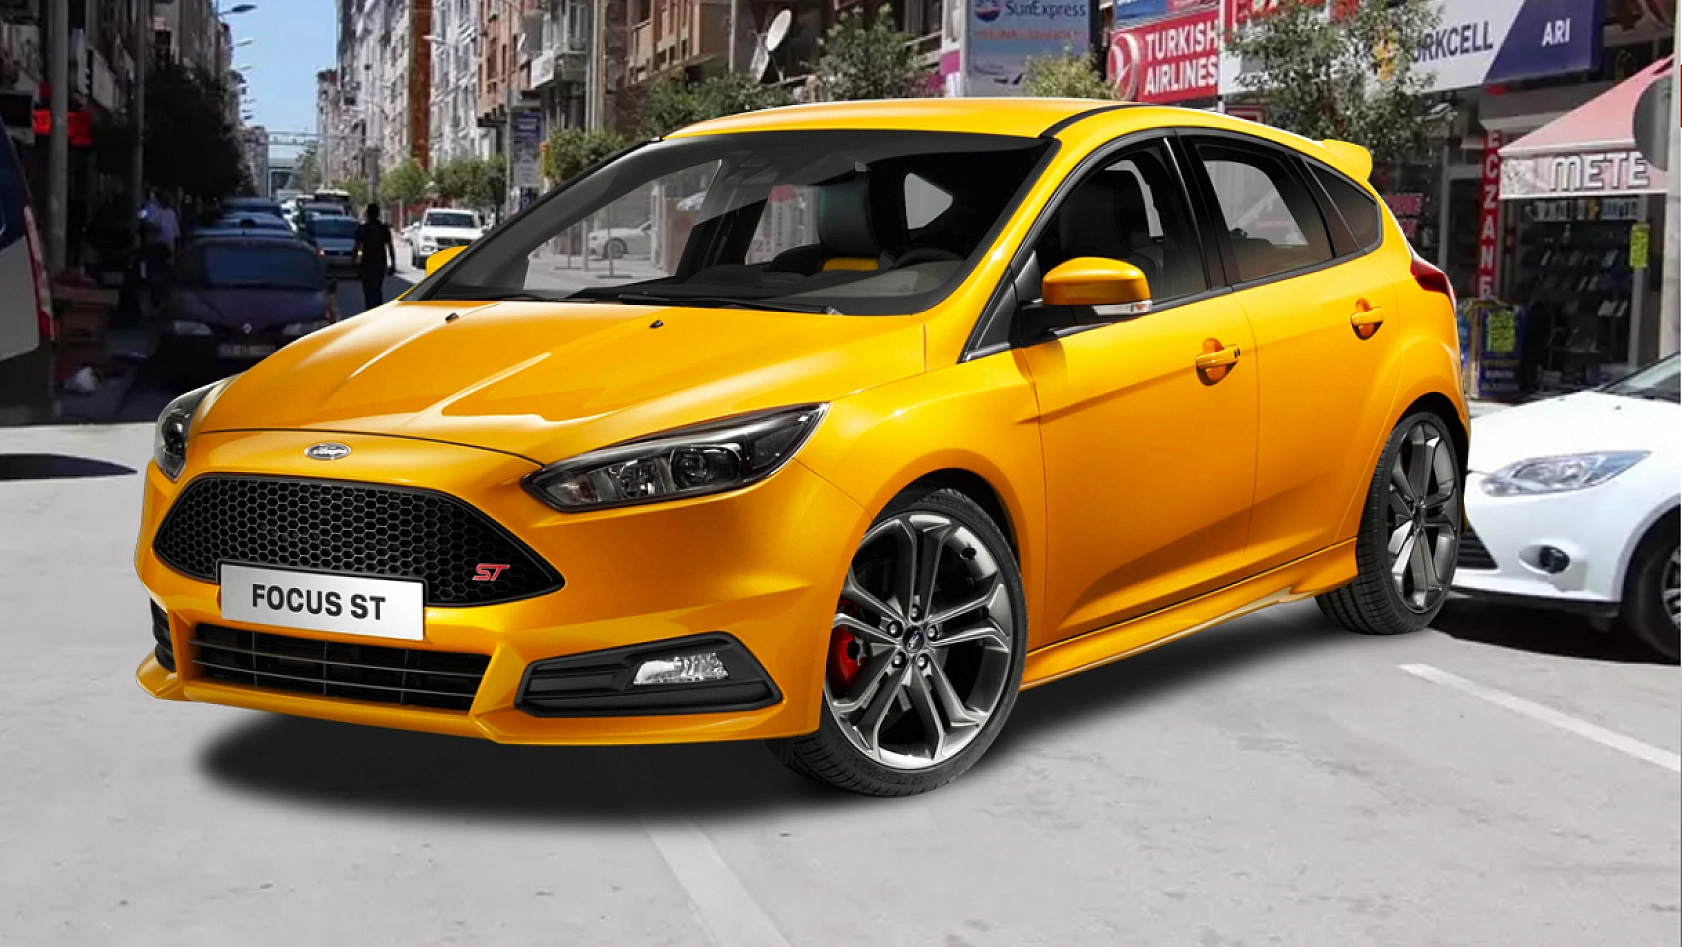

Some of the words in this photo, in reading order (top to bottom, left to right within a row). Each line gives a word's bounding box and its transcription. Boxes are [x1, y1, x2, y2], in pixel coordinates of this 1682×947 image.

[1005, 1, 1087, 19] SunExpress
[1144, 20, 1218, 62] TURKISH
[1144, 55, 1218, 95] AIRLINES
[1549, 151, 1651, 191] METE
[472, 563, 510, 581] ST
[252, 583, 342, 617] FOCUS
[350, 593, 386, 620] ST
